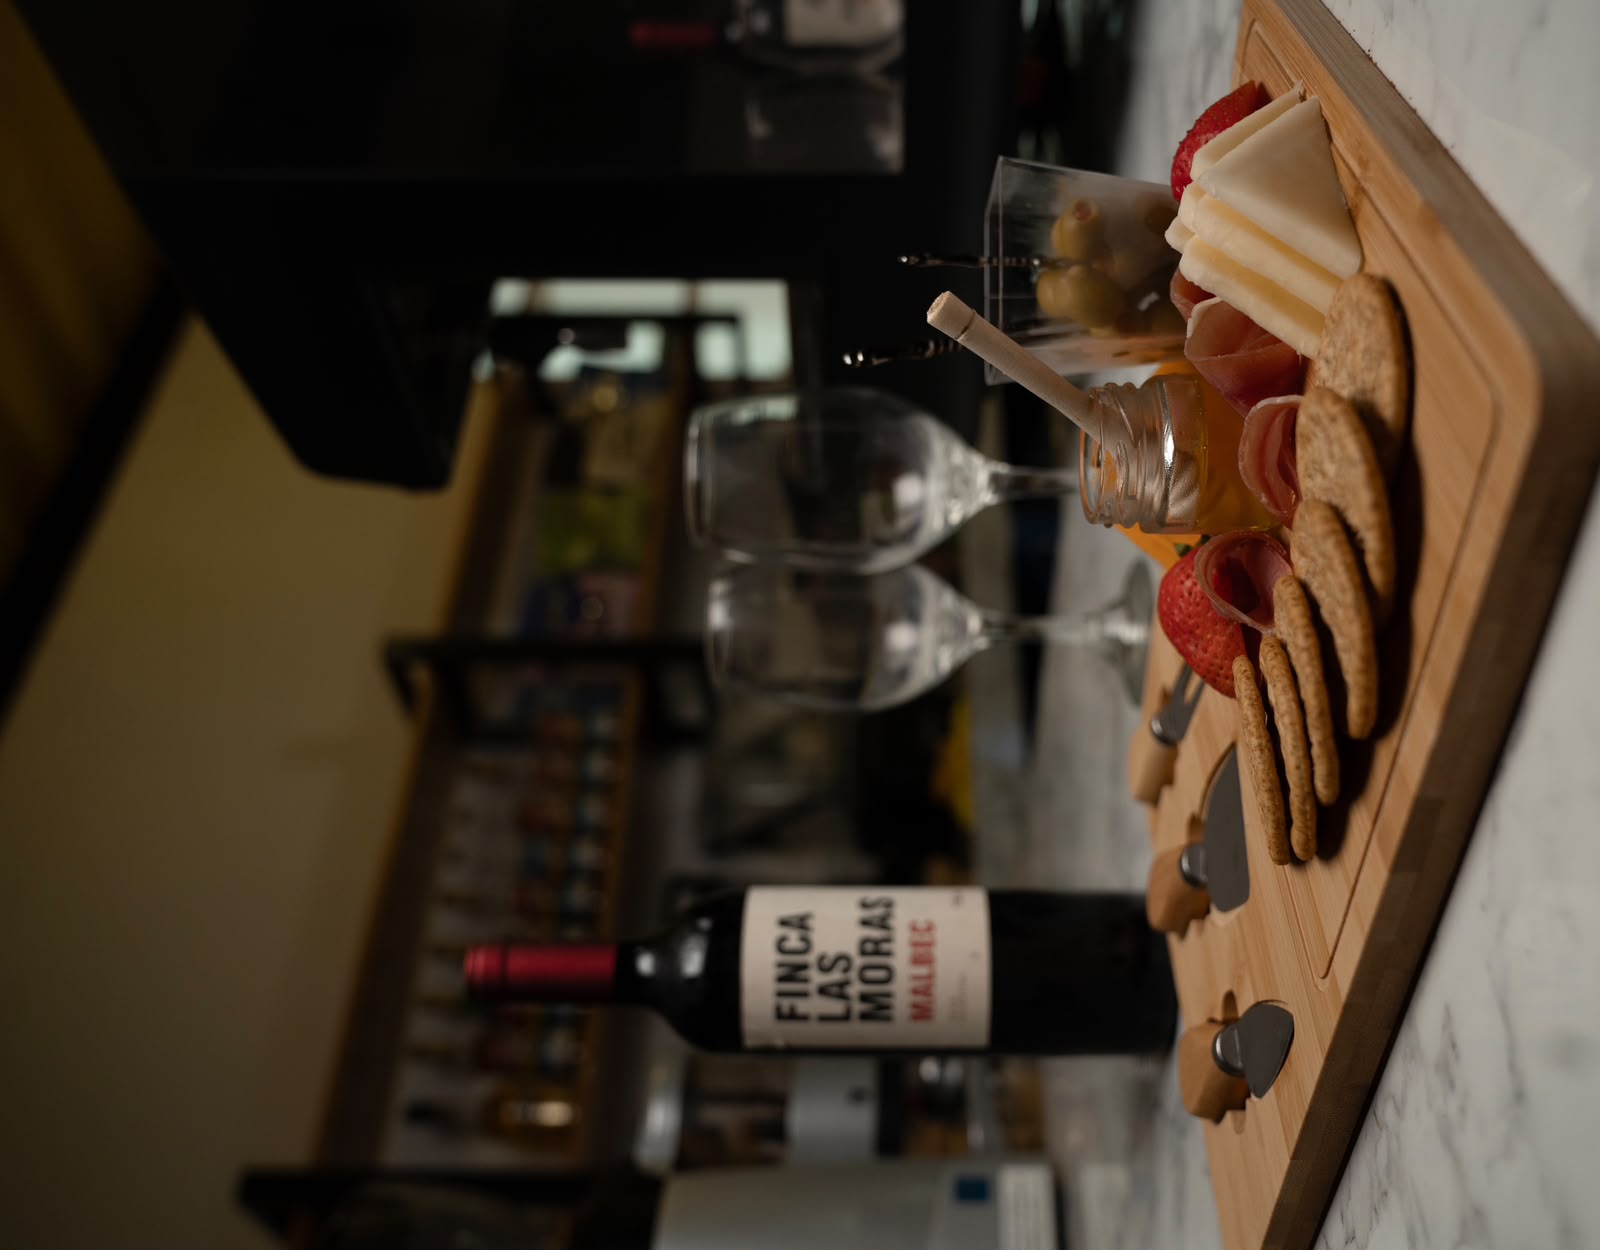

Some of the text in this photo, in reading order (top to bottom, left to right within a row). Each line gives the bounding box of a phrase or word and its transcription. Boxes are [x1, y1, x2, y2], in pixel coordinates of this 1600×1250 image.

[776, 911, 813, 1022] FINCA
[817, 952, 853, 1022] LAS
[859, 897, 895, 1022] MORAS
[910, 919, 936, 1023] MALBEC
